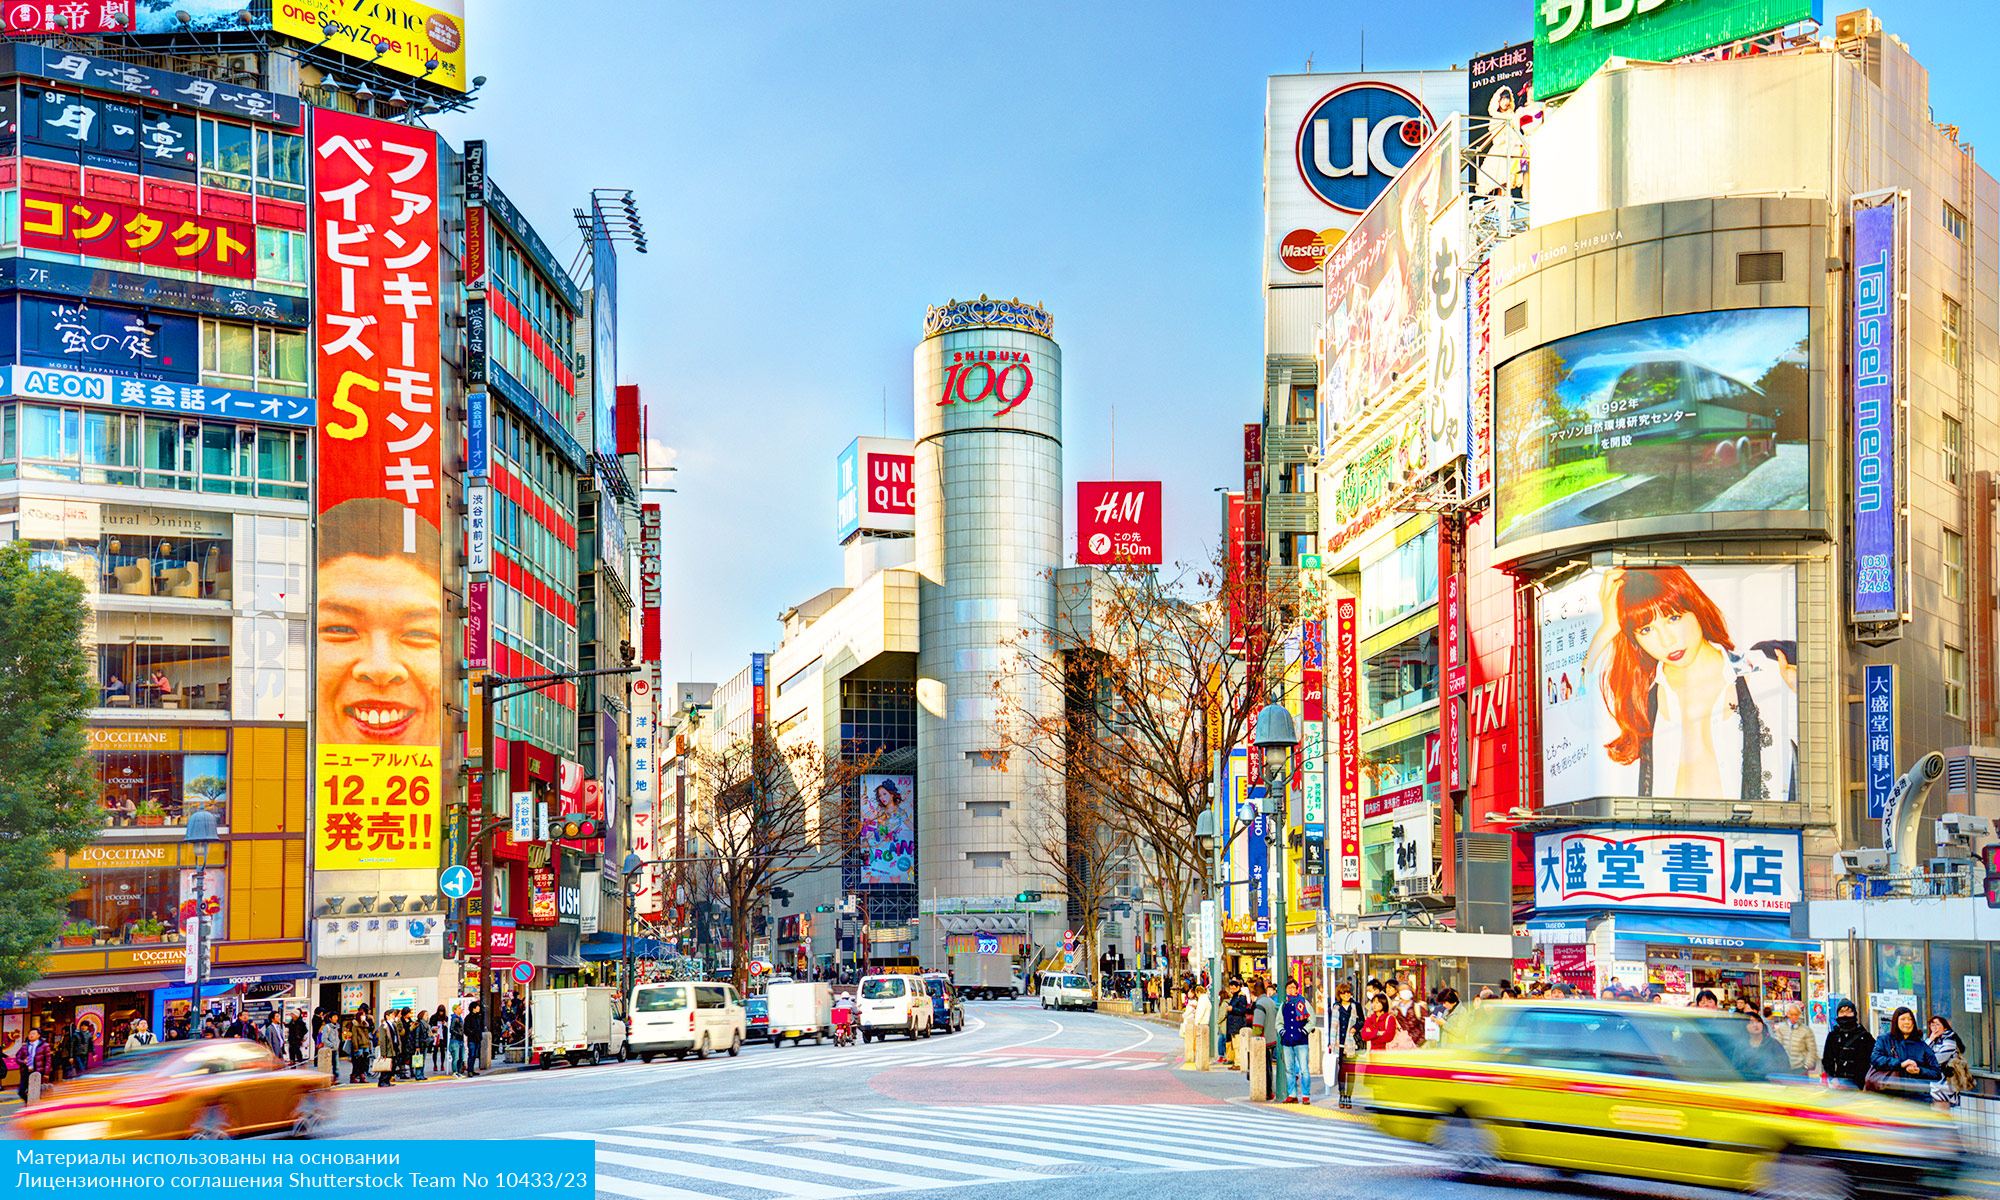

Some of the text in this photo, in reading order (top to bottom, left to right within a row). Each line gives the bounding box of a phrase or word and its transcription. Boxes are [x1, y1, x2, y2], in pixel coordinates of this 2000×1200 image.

[59, 1, 129, 30] 帝劇
[283, 4, 315, 24] one
[442, 60, 456, 74] 発売
[1472, 48, 1527, 76] 柏木由紀
[46, 55, 273, 117] 月の宴 月の宴
[1472, 77, 1489, 89] DVD
[45, 92, 66, 104] 9F
[45, 105, 185, 158] 月の宴
[24, 199, 247, 262] コンタクト
[1530, 244, 1567, 270] Vision
[1574, 230, 1623, 251] SHIBUYA
[29, 268, 48, 282] 7F
[318, 136, 379, 440] ベイビーズ 5
[111, 283, 220, 303] MODERN JAPANESE DINING
[382, 140, 435, 553] ファンキーモンキー
[953, 351, 1030, 364] SHIBUYA
[26, 371, 103, 398] AEON
[49, 362, 164, 380] MODERN JAPANESE DINING
[1858, 249, 1887, 513] Taisei neon
[120, 380, 309, 420] 英会話イーオン
[936, 361, 1033, 418] 109
[1594, 398, 1639, 415] 1992年
[1550, 410, 1697, 443] アマゾン自然環境研究センター
[1601, 435, 1633, 450] を開設
[1094, 491, 1145, 524] H&M
[150, 515, 202, 531] Dining
[472, 494, 484, 565] 渋谷駅前ビル
[1113, 543, 1151, 556] 150m
[1114, 532, 1141, 542] この先
[1860, 568, 1889, 581] 3719
[1861, 555, 1887, 568] (03)
[470, 583, 486, 592] 5F
[1860, 581, 1890, 593] 2468
[1305, 691, 1322, 701] JTB
[636, 716, 648, 792] 洋装生地
[1871, 676, 1890, 809] 大盛堂商事ビル
[324, 753, 433, 767] ニューアルバム
[324, 775, 430, 806] 12.26
[521, 796, 529, 837] 渋谷駅前
[324, 812, 431, 851] 発売!!
[82, 847, 165, 861] L'OCCITANE
[634, 813, 649, 897] マルン
[1541, 842, 1784, 895] 大盛堂書店
[559, 886, 580, 915] USH
[1733, 899, 1759, 908] BOOKS
[977, 943, 998, 953] 109
[1688, 937, 1744, 947] TAISEIDO
[132, 950, 187, 962] L'OCCITAN
[229, 975, 262, 984] KIOSQUE
